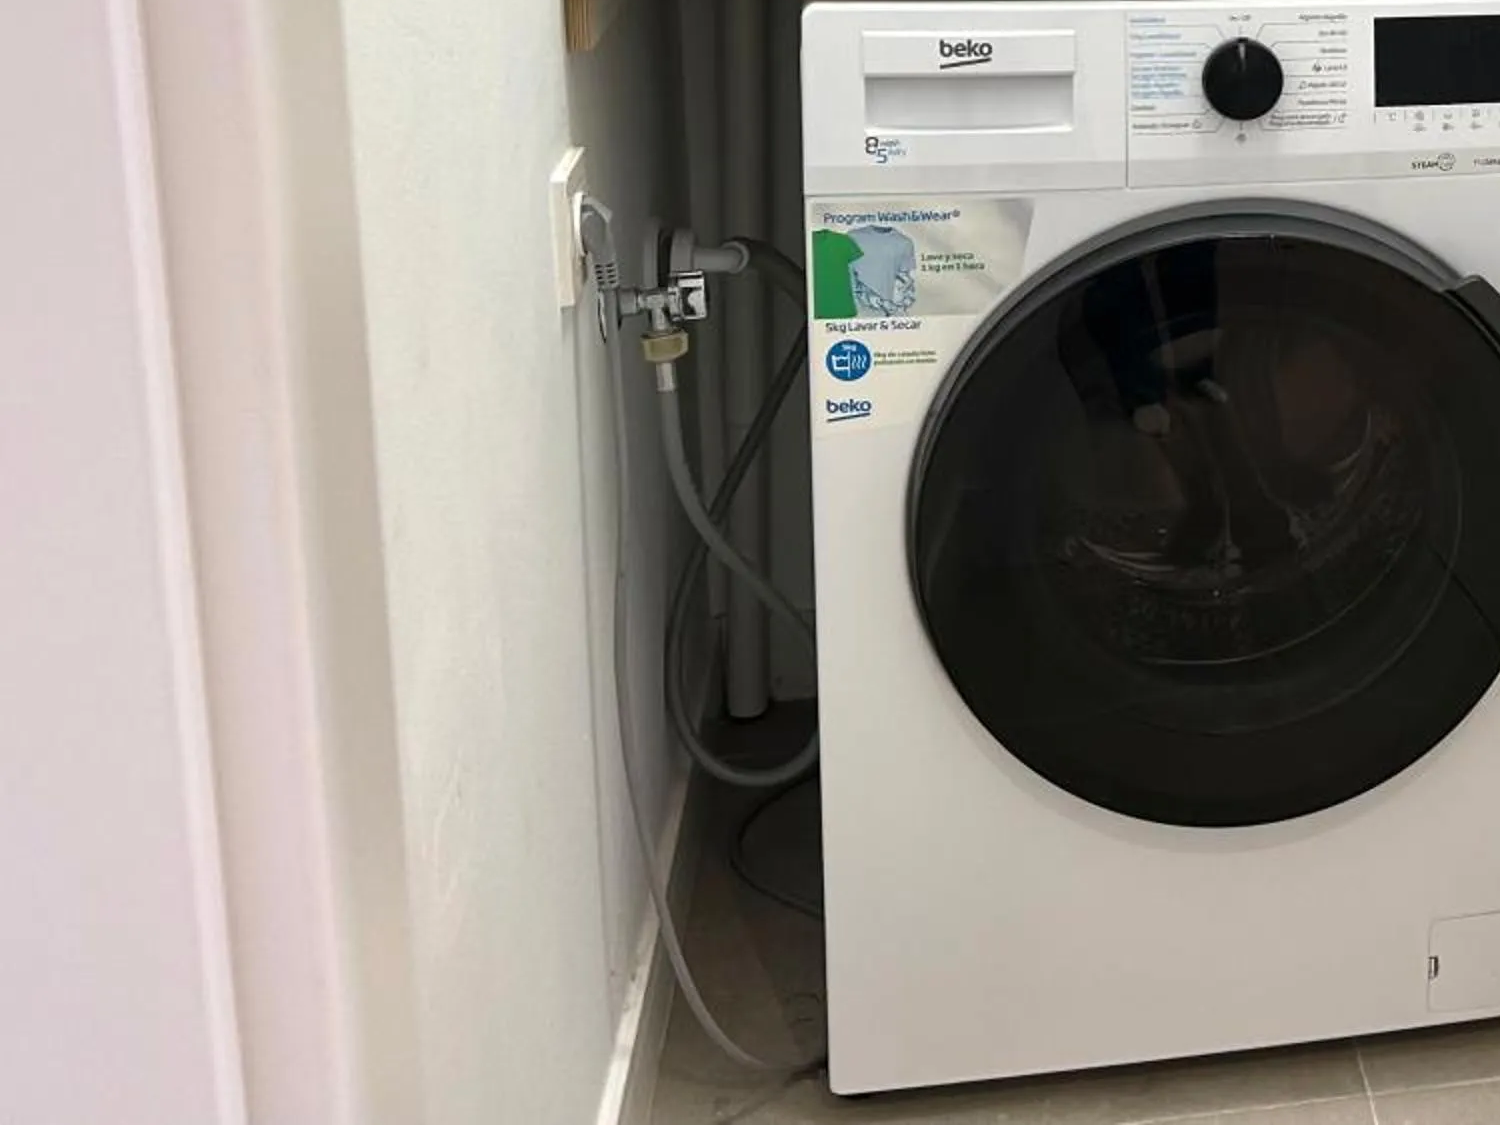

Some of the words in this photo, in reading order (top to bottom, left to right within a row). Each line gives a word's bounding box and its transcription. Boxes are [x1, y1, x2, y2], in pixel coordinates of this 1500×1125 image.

[940, 39, 993, 57] beko
[865, 136, 879, 154] 8
[876, 148, 887, 163] 5
[823, 213, 876, 225] Program
[848, 321, 878, 331] Lavar
[880, 321, 888, 330] &
[891, 320, 921, 329] Secar
[826, 398, 872, 413] beko
